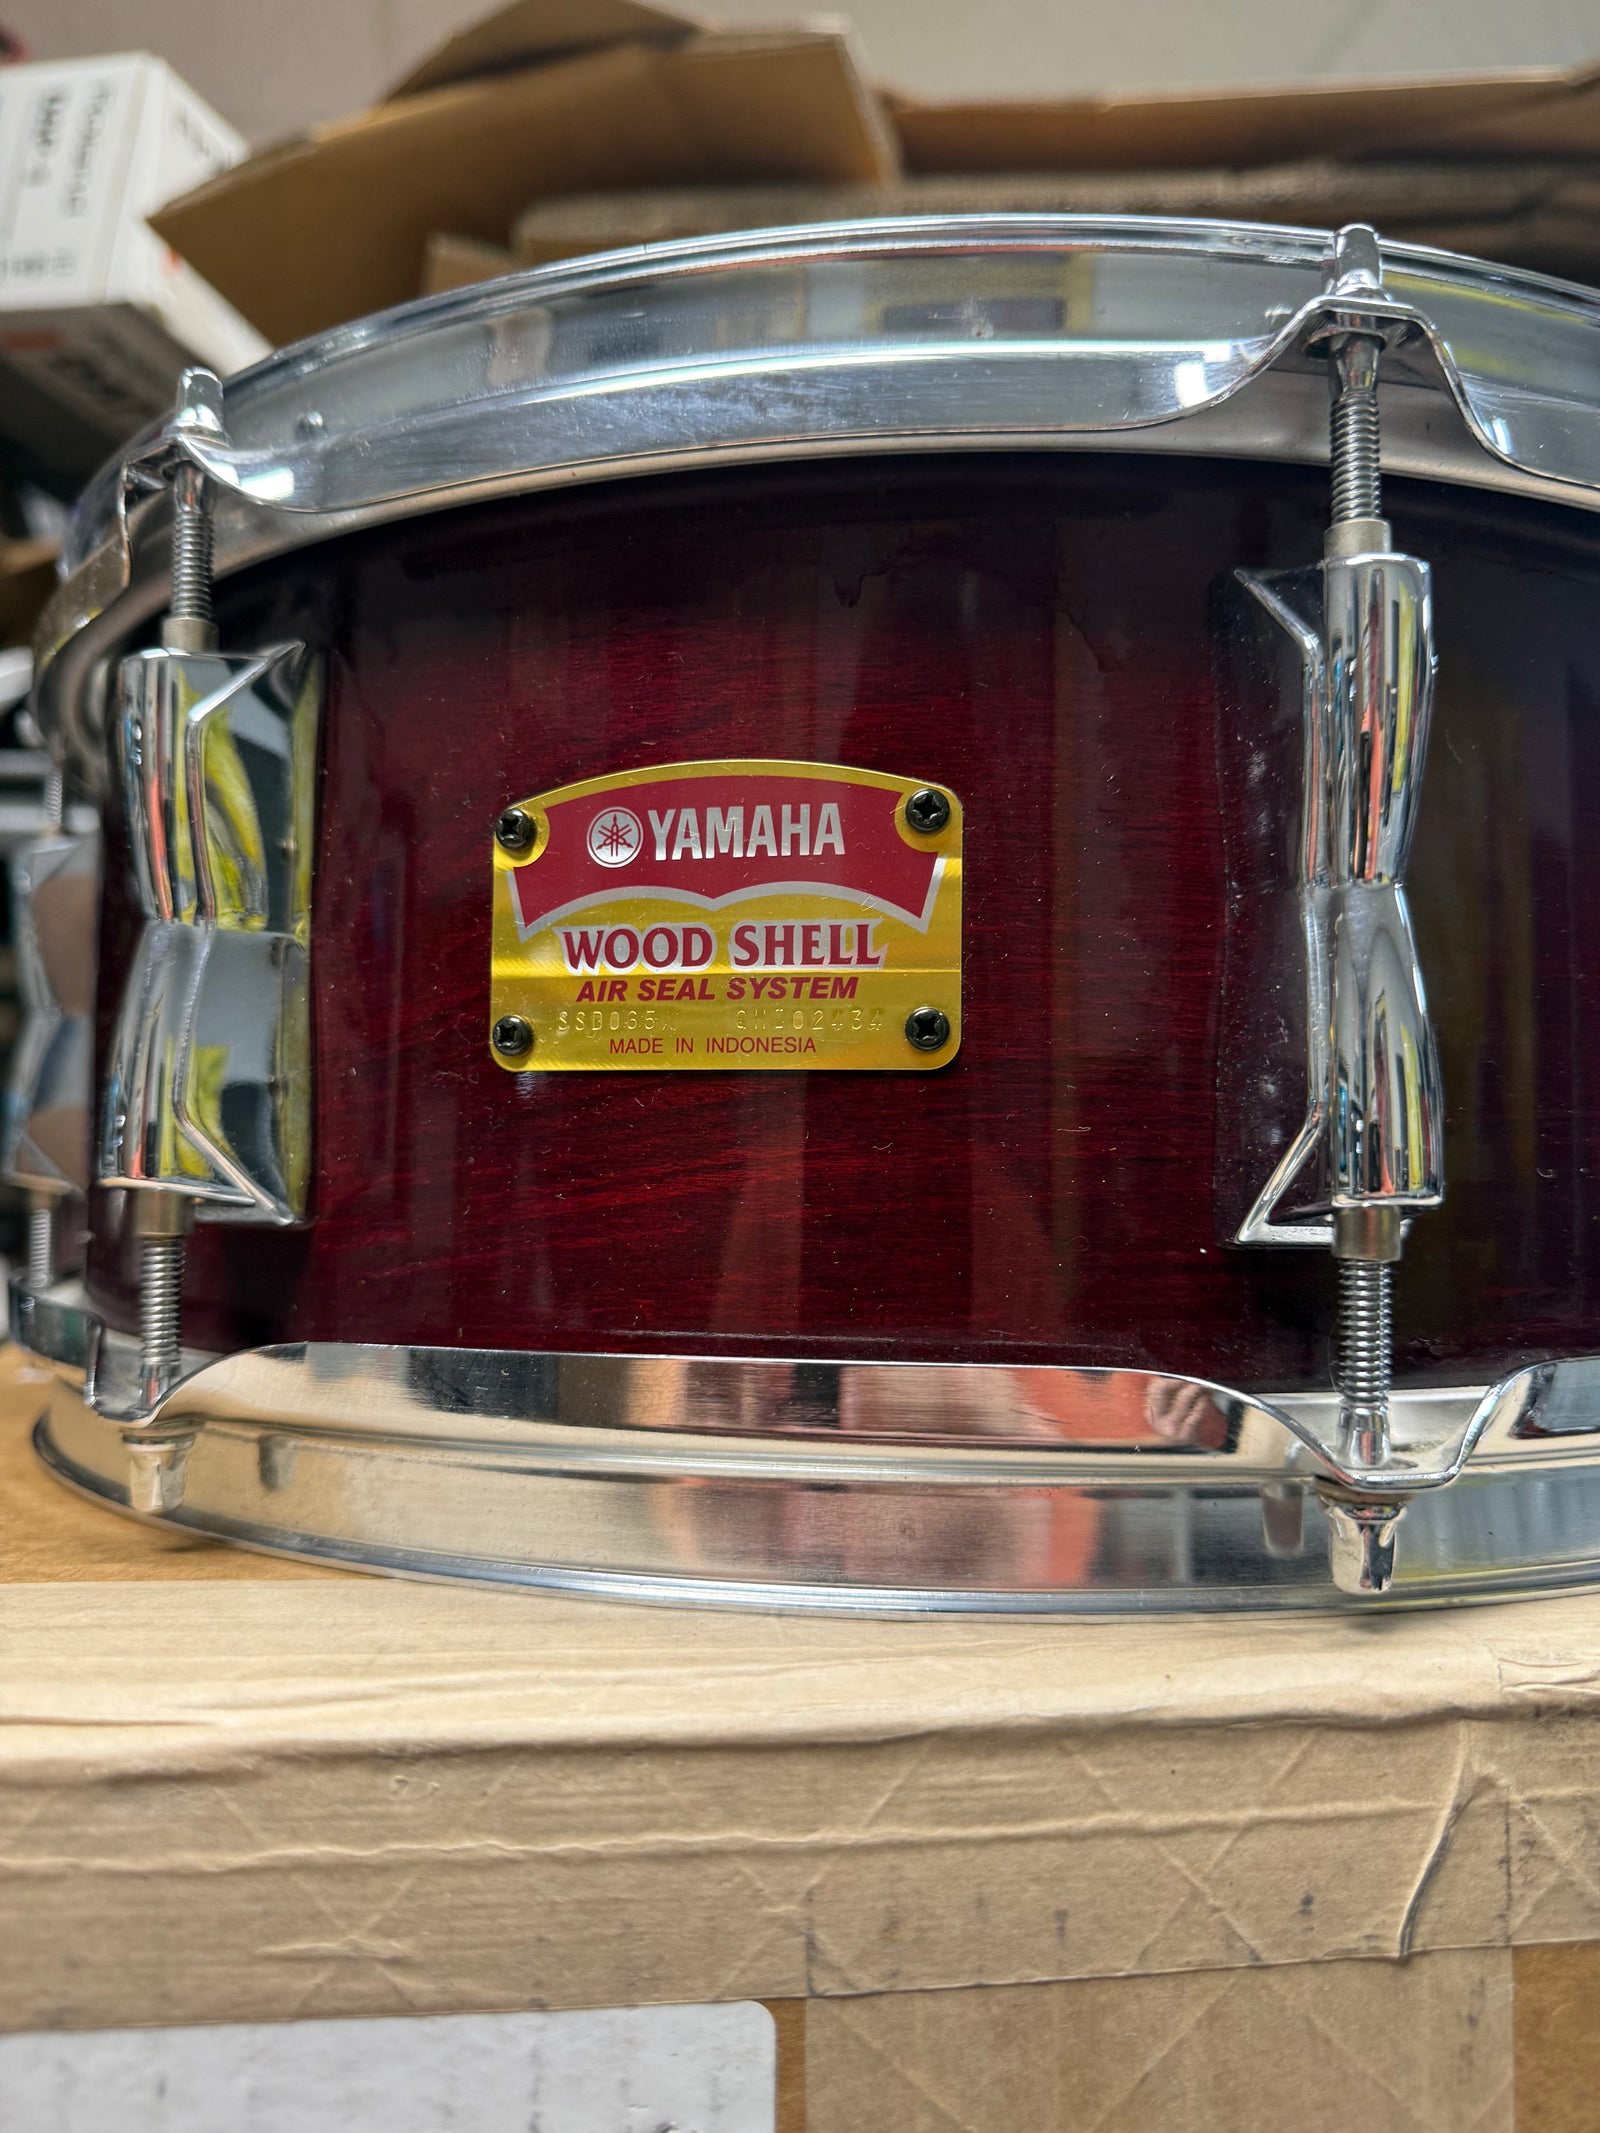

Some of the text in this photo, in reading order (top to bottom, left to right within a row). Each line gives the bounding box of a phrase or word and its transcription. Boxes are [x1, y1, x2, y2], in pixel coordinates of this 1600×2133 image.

[647, 802, 845, 861] YAMAHA
[562, 923, 881, 971] WOOD SHELL
[575, 976, 859, 1003] AIR SEAL SYSTEM
[609, 1036, 817, 1055] MADE IN INDONESIA
